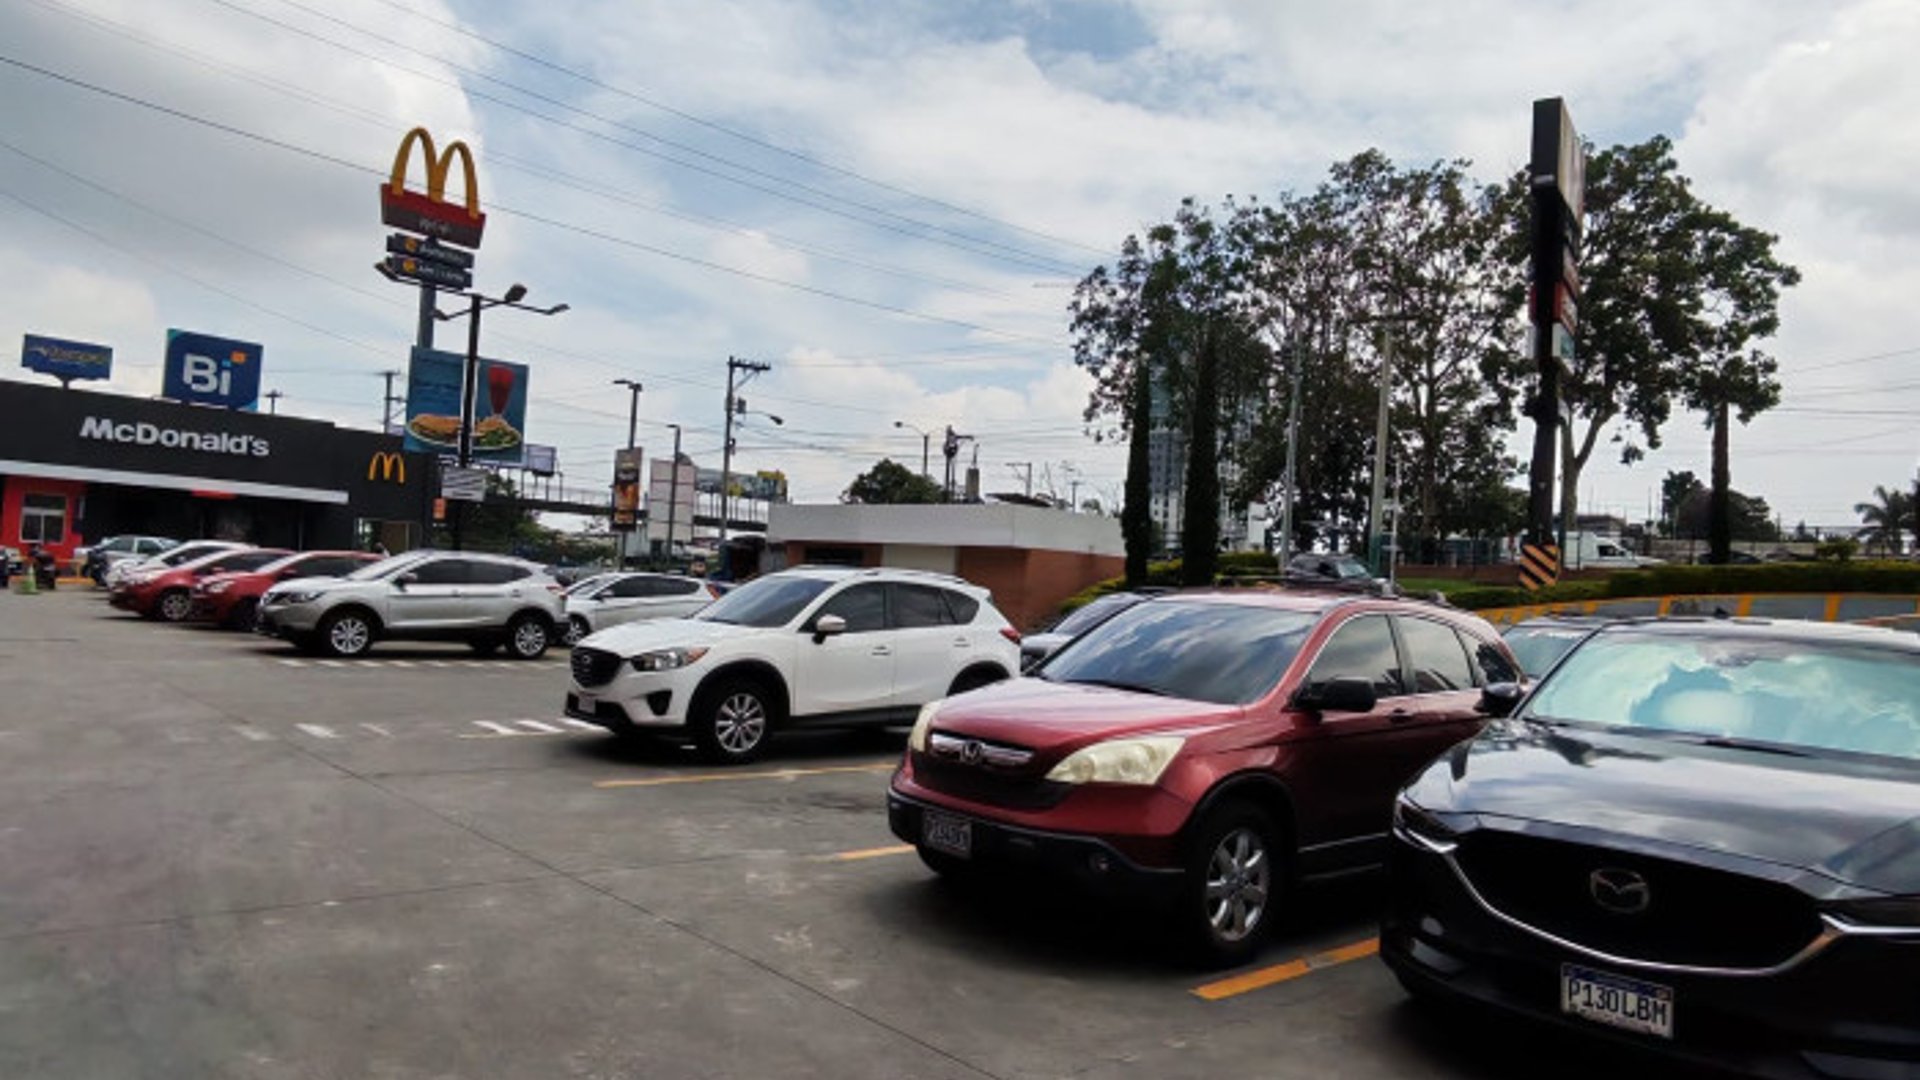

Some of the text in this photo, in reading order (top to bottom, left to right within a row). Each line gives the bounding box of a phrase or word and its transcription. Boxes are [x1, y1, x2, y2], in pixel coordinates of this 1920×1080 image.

[183, 353, 231, 396] Bi
[79, 416, 270, 457] McDonald's
[1567, 978, 1667, 1027] P130LBM
